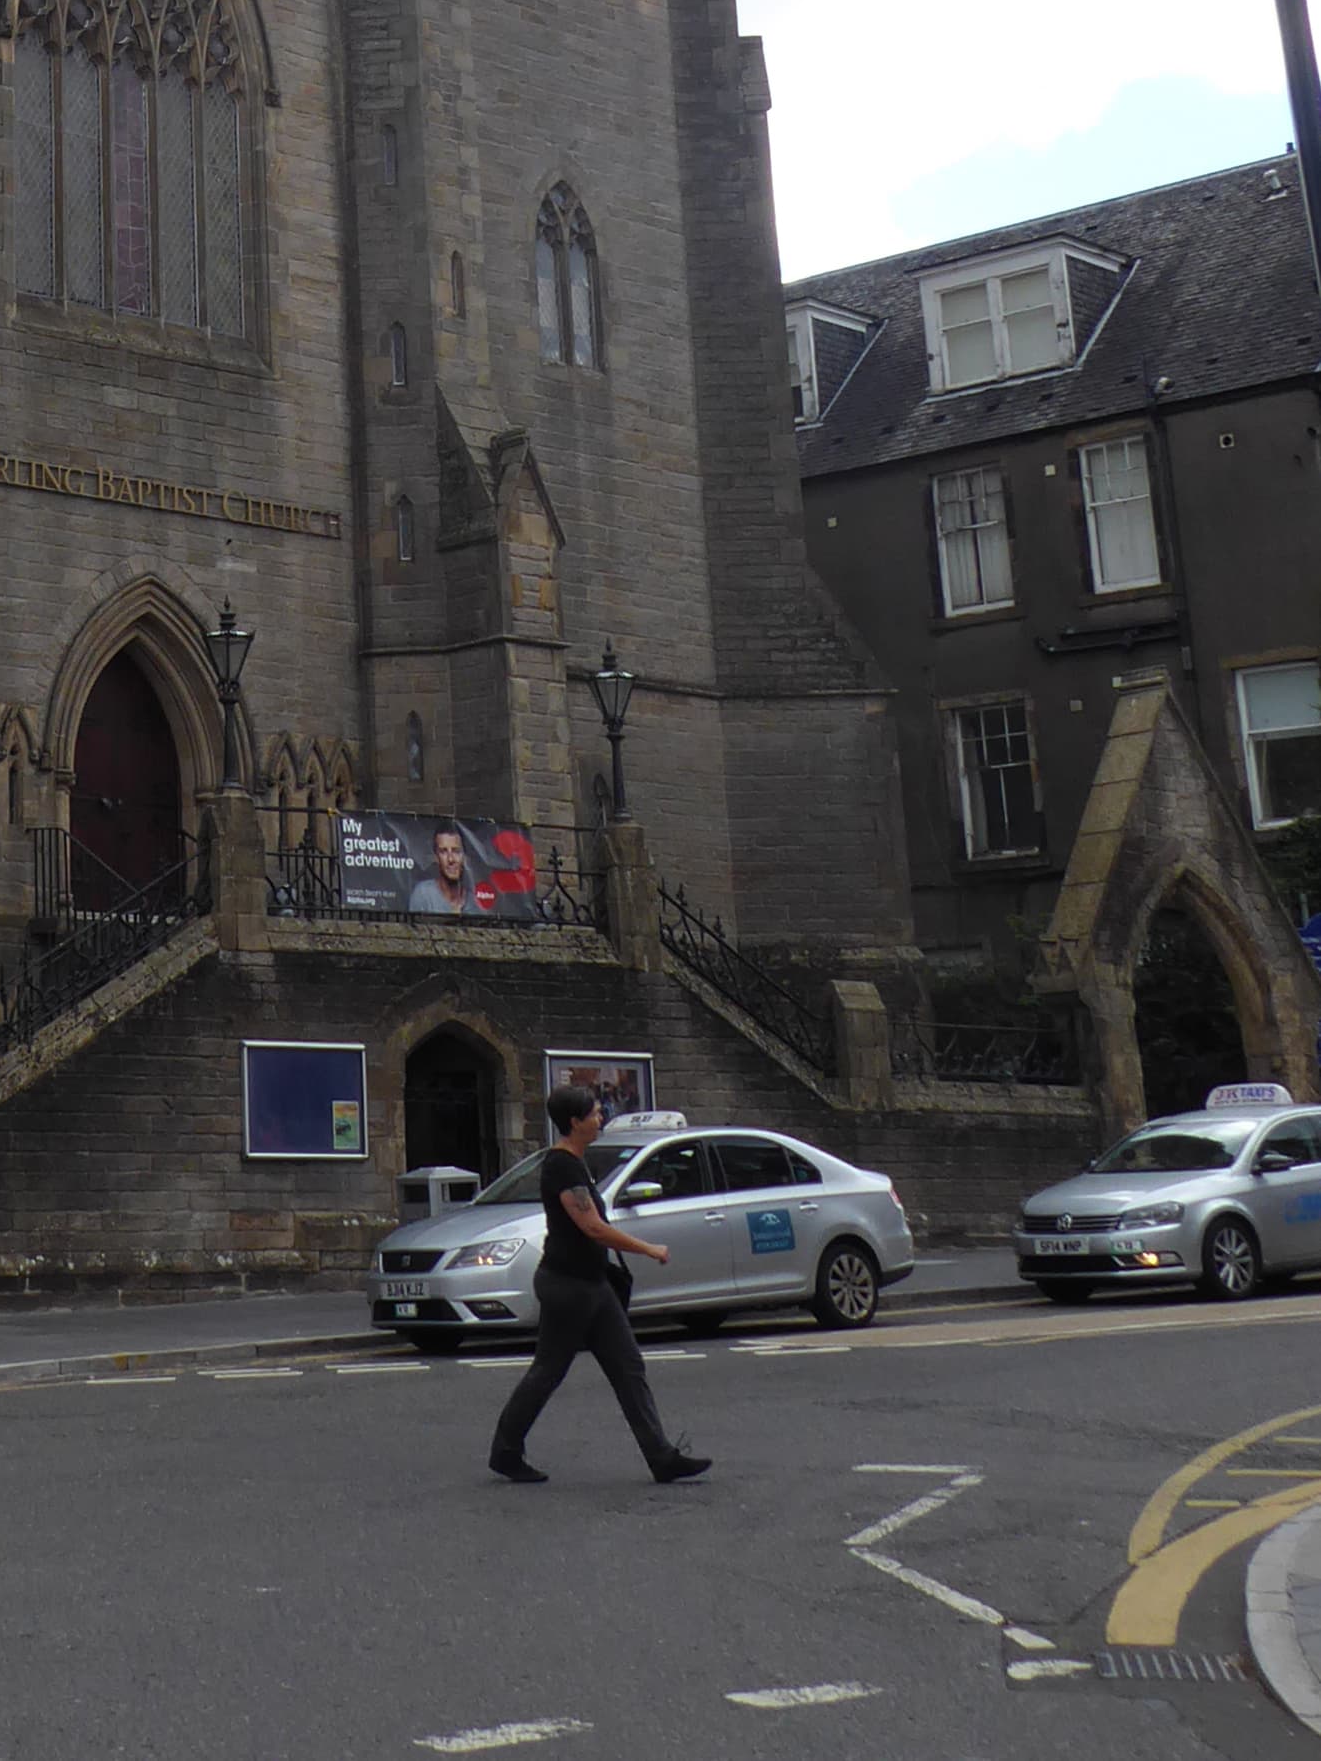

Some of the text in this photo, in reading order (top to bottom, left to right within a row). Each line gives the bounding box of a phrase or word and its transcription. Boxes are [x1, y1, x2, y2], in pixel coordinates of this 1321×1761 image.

[96, 466, 215, 516] BAPTIST
[222, 490, 342, 539] CHURCH
[342, 818, 362, 837] My
[343, 837, 400, 853] greatest
[344, 853, 415, 870] adventure
